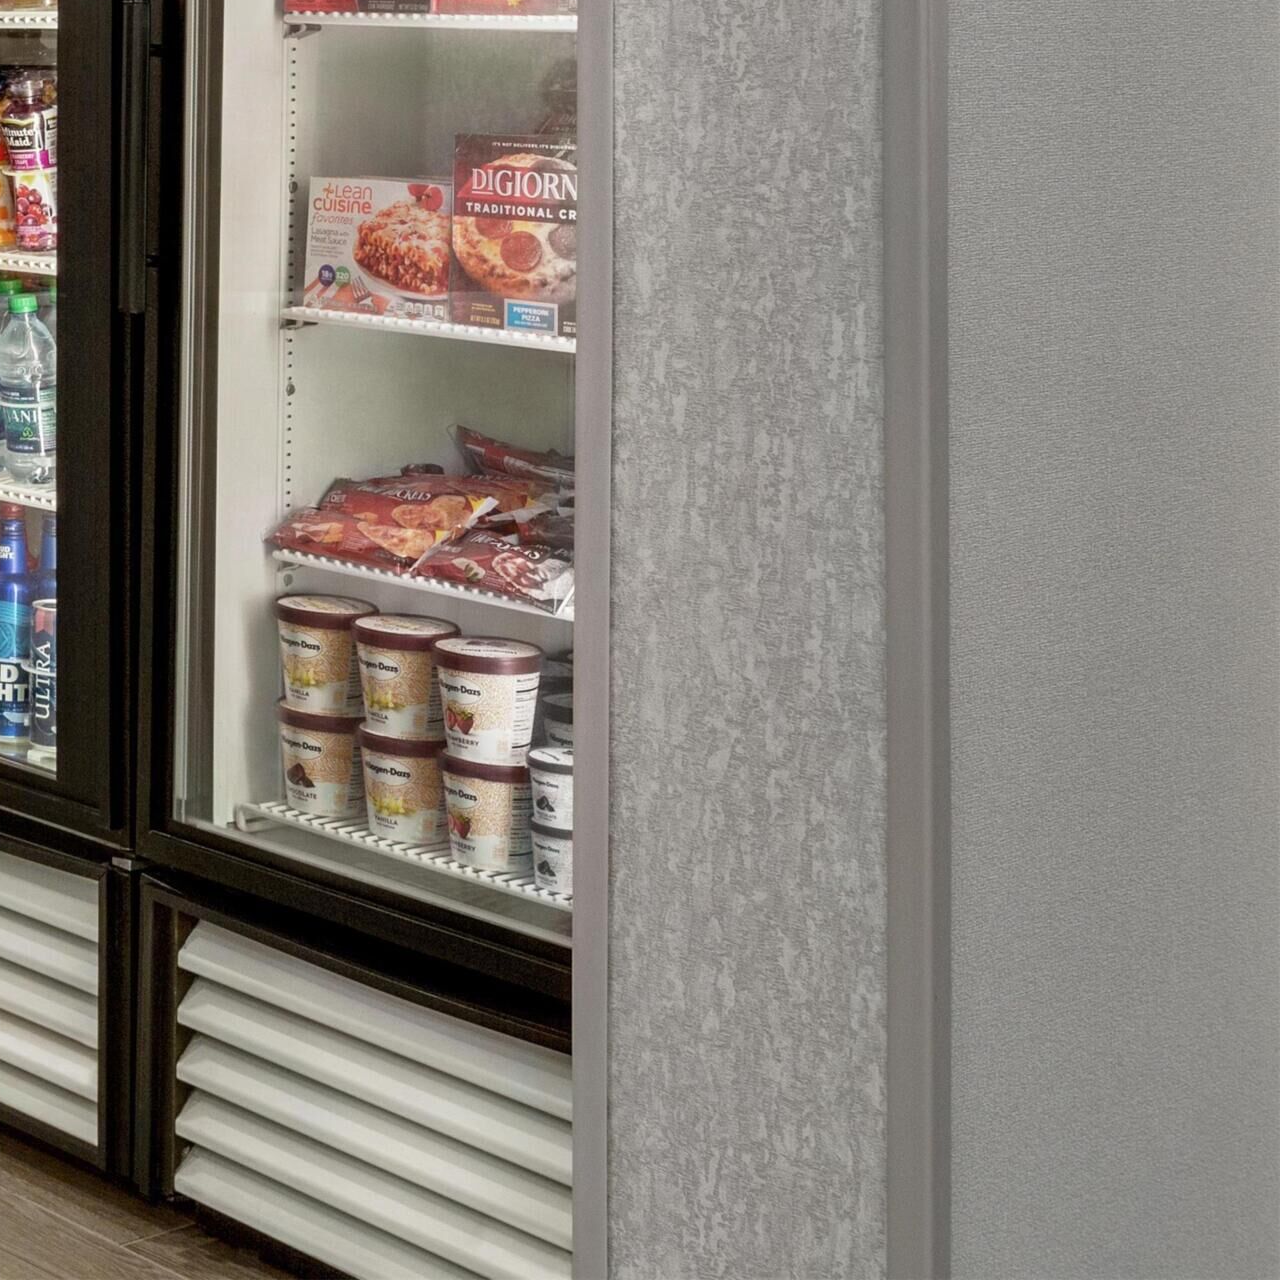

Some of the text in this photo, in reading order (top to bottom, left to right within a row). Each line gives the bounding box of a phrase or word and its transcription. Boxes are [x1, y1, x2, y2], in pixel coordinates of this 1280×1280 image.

[466, 202, 553, 218] TRADITIONAL
[311, 212, 353, 226] favorites
[312, 228, 338, 236] Lasagna
[311, 235, 327, 243] Meat
[521, 314, 541, 322] PIZZA
[35, 641, 51, 719] ULTRA
